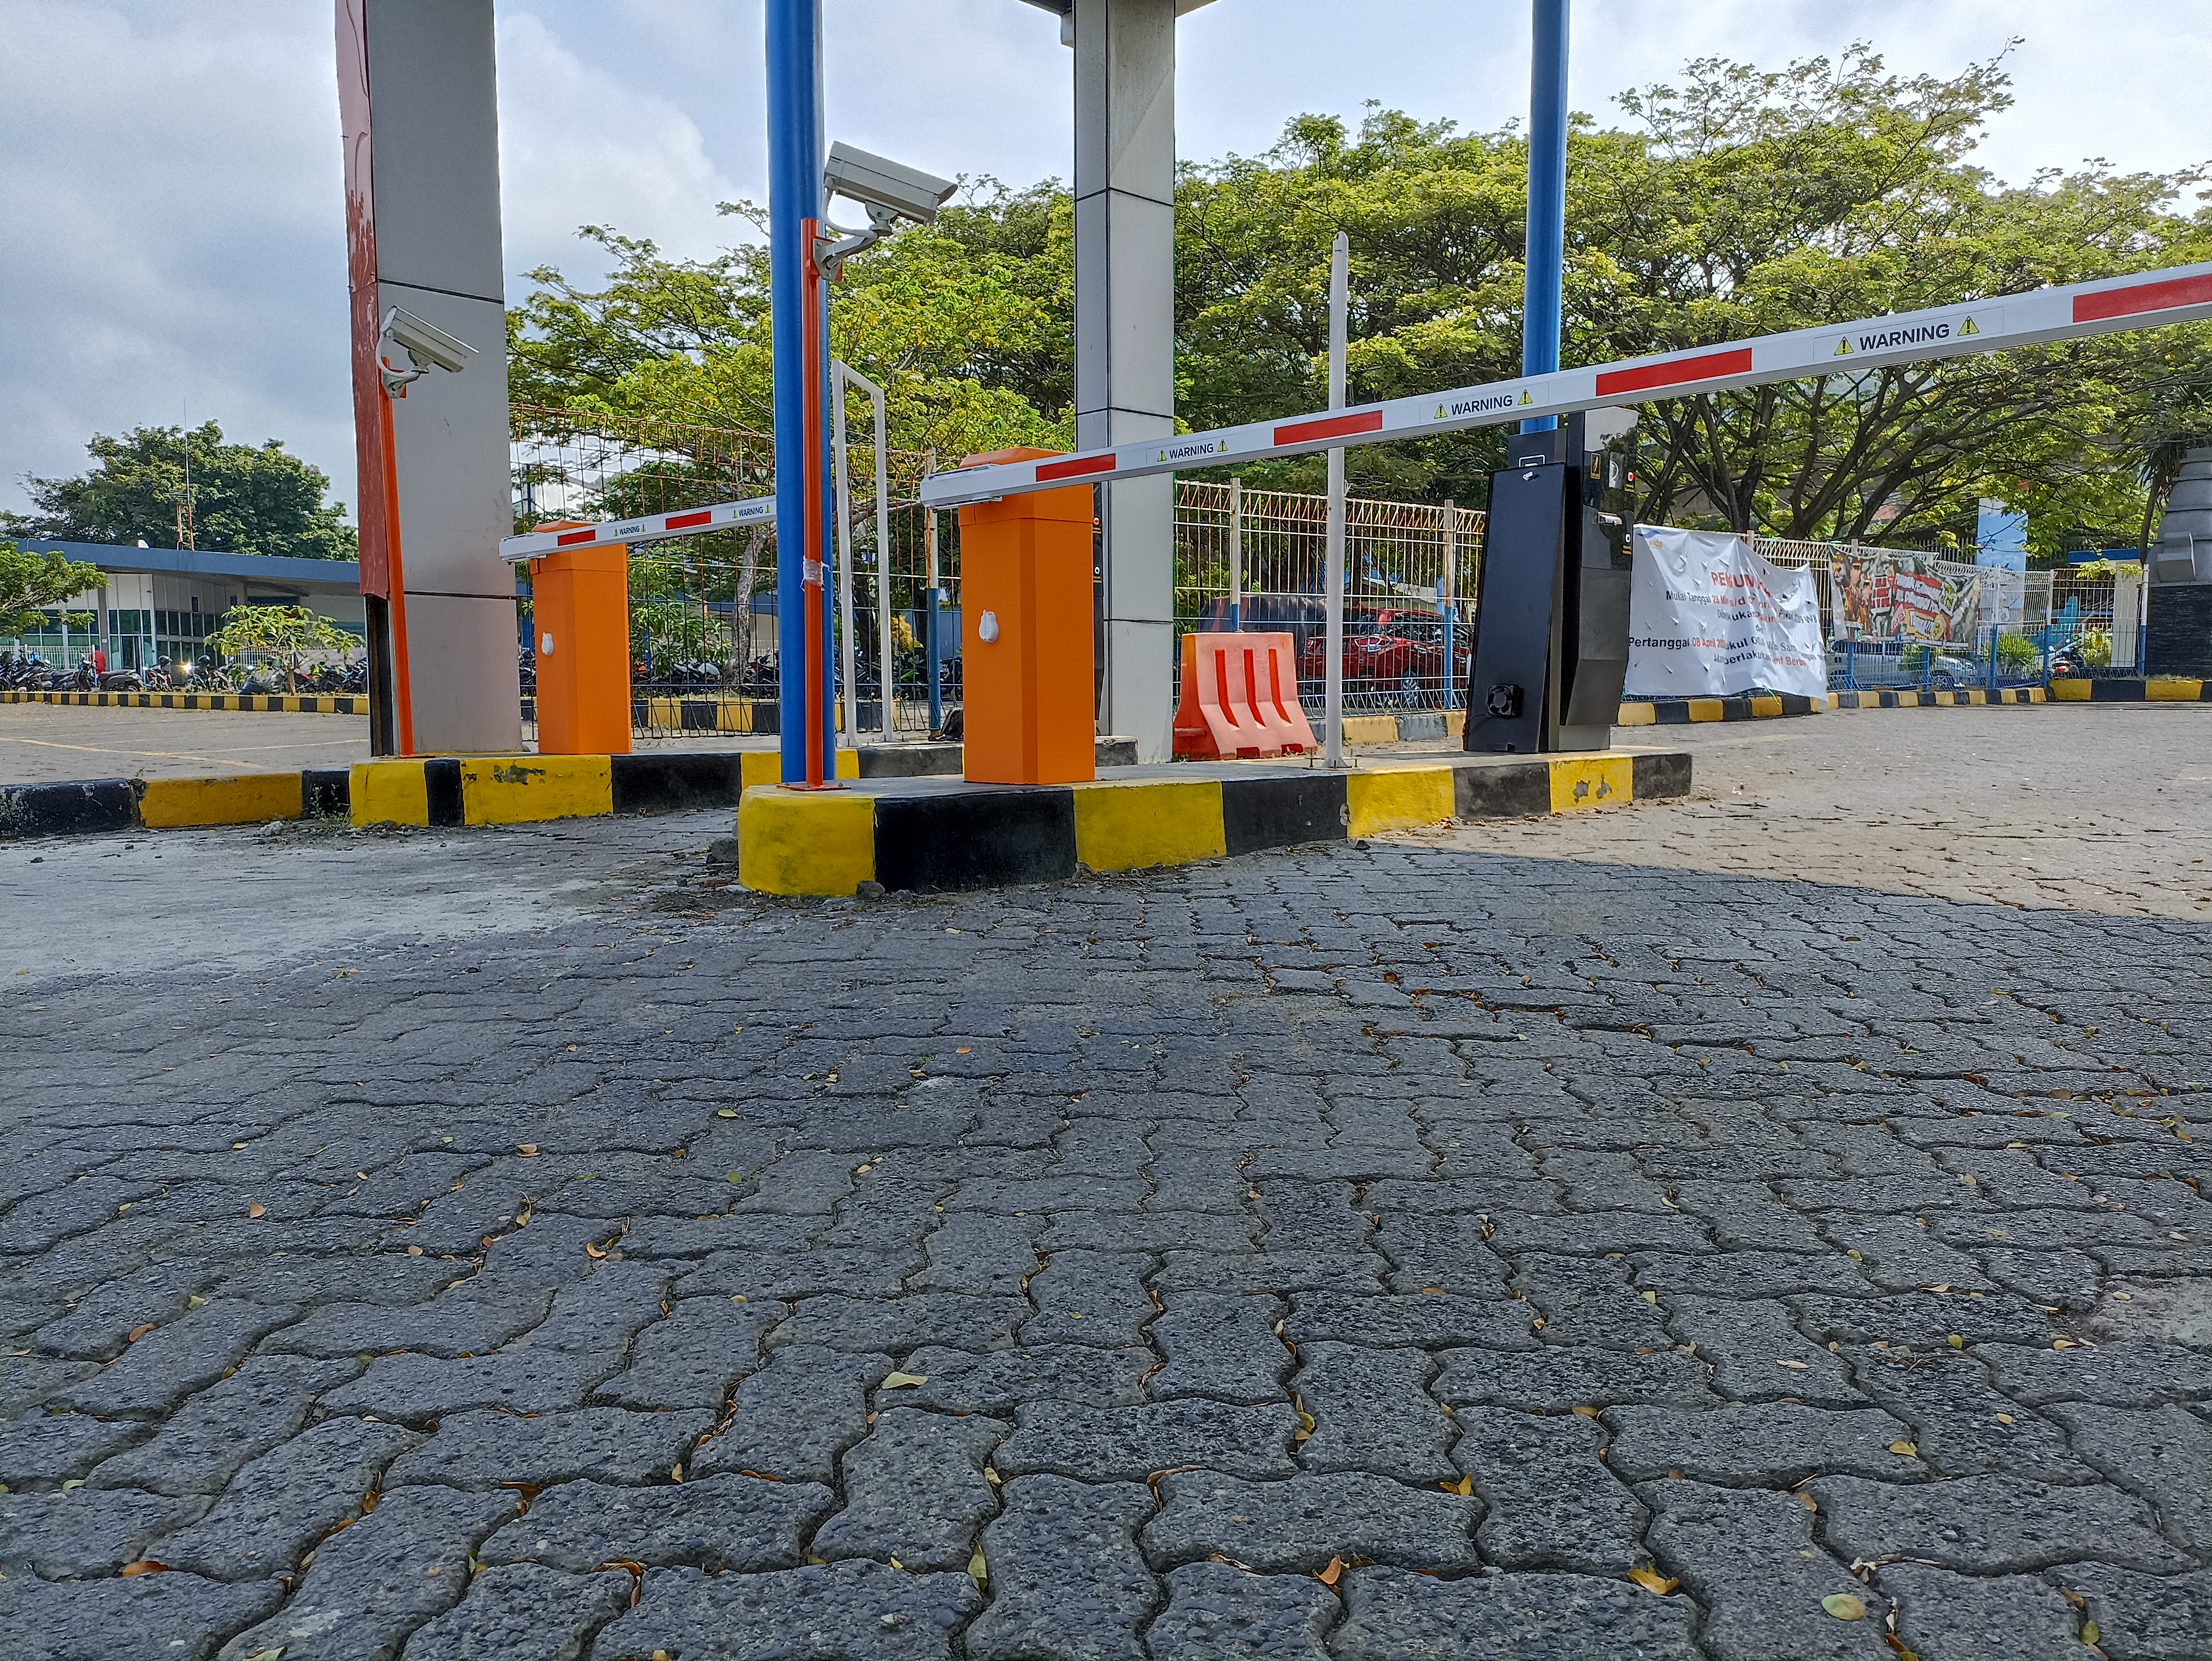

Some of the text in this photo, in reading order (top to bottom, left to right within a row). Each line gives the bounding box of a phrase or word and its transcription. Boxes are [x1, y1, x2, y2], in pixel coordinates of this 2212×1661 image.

[1859, 323, 1949, 351] WARNING
[1451, 395, 1512, 415] WARNING
[1169, 443, 1214, 459] WARNING
[739, 506, 763, 517] WARNING
[619, 526, 640, 535] WARNING
[1666, 590, 1686, 601] Mulai
[1687, 592, 1711, 605] Tanggal
[1712, 595, 1720, 604] 28
[1629, 637, 1690, 650] Pertanggal
[1692, 637, 1701, 647] 08
[1702, 638, 1716, 649] April
